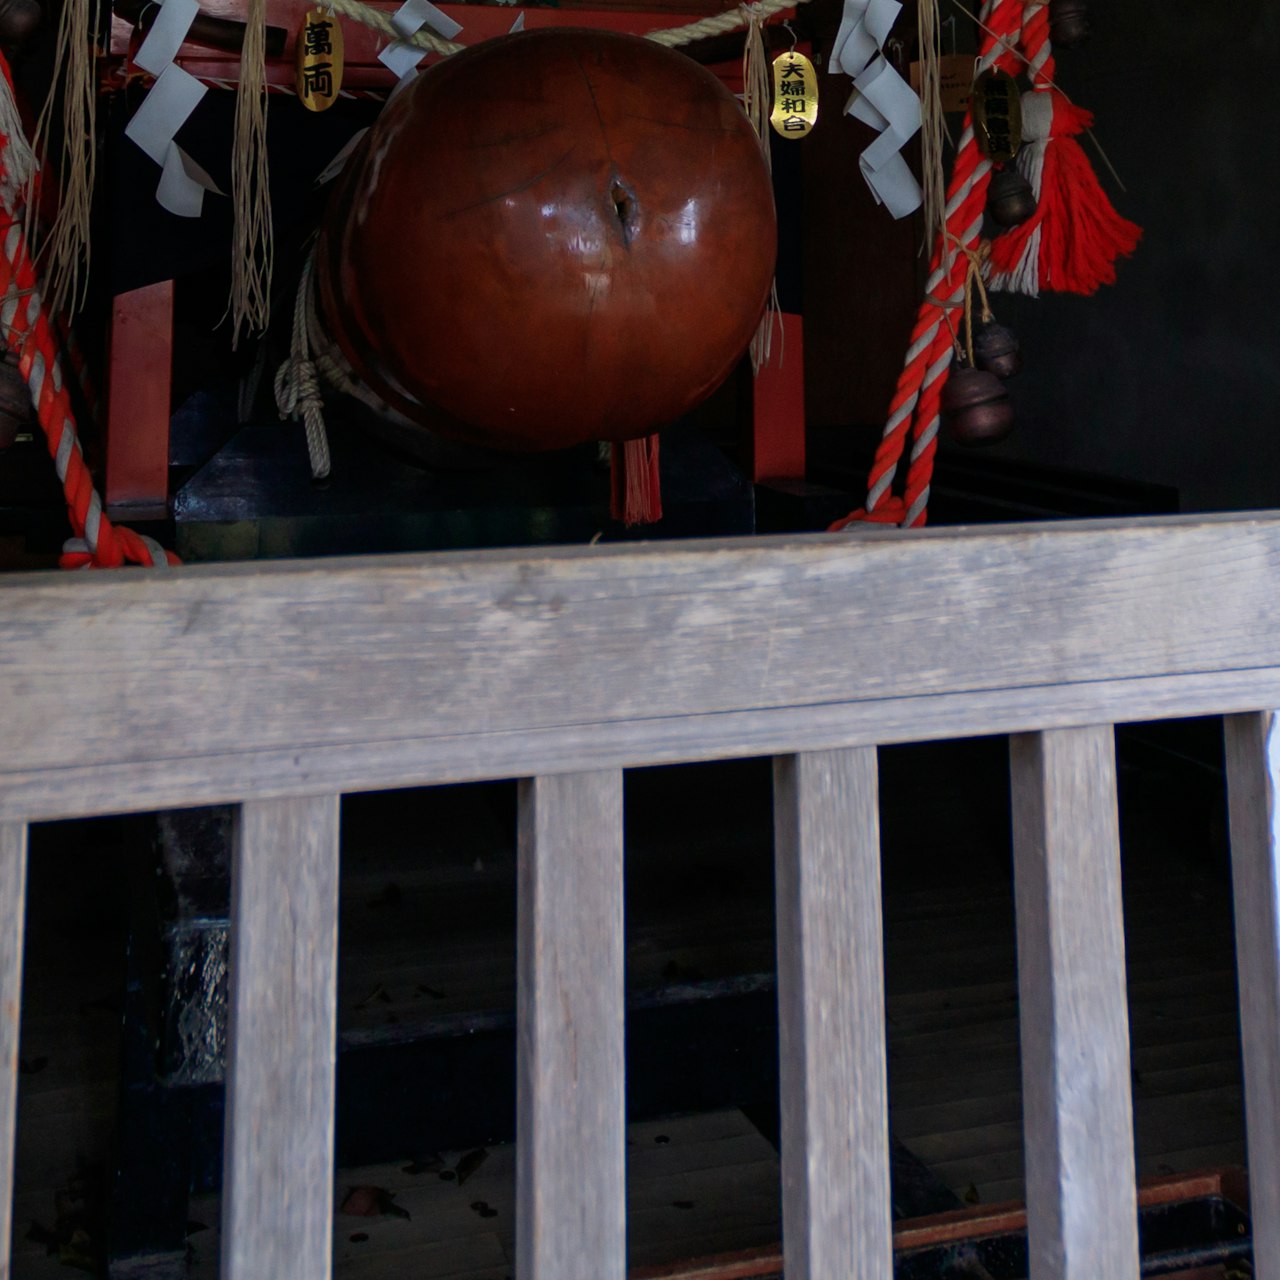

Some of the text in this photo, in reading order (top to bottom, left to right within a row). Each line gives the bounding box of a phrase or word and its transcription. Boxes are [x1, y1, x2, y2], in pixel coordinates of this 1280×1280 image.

[303, 20, 333, 99] 萬両
[779, 62, 806, 131] 夫婦和合
